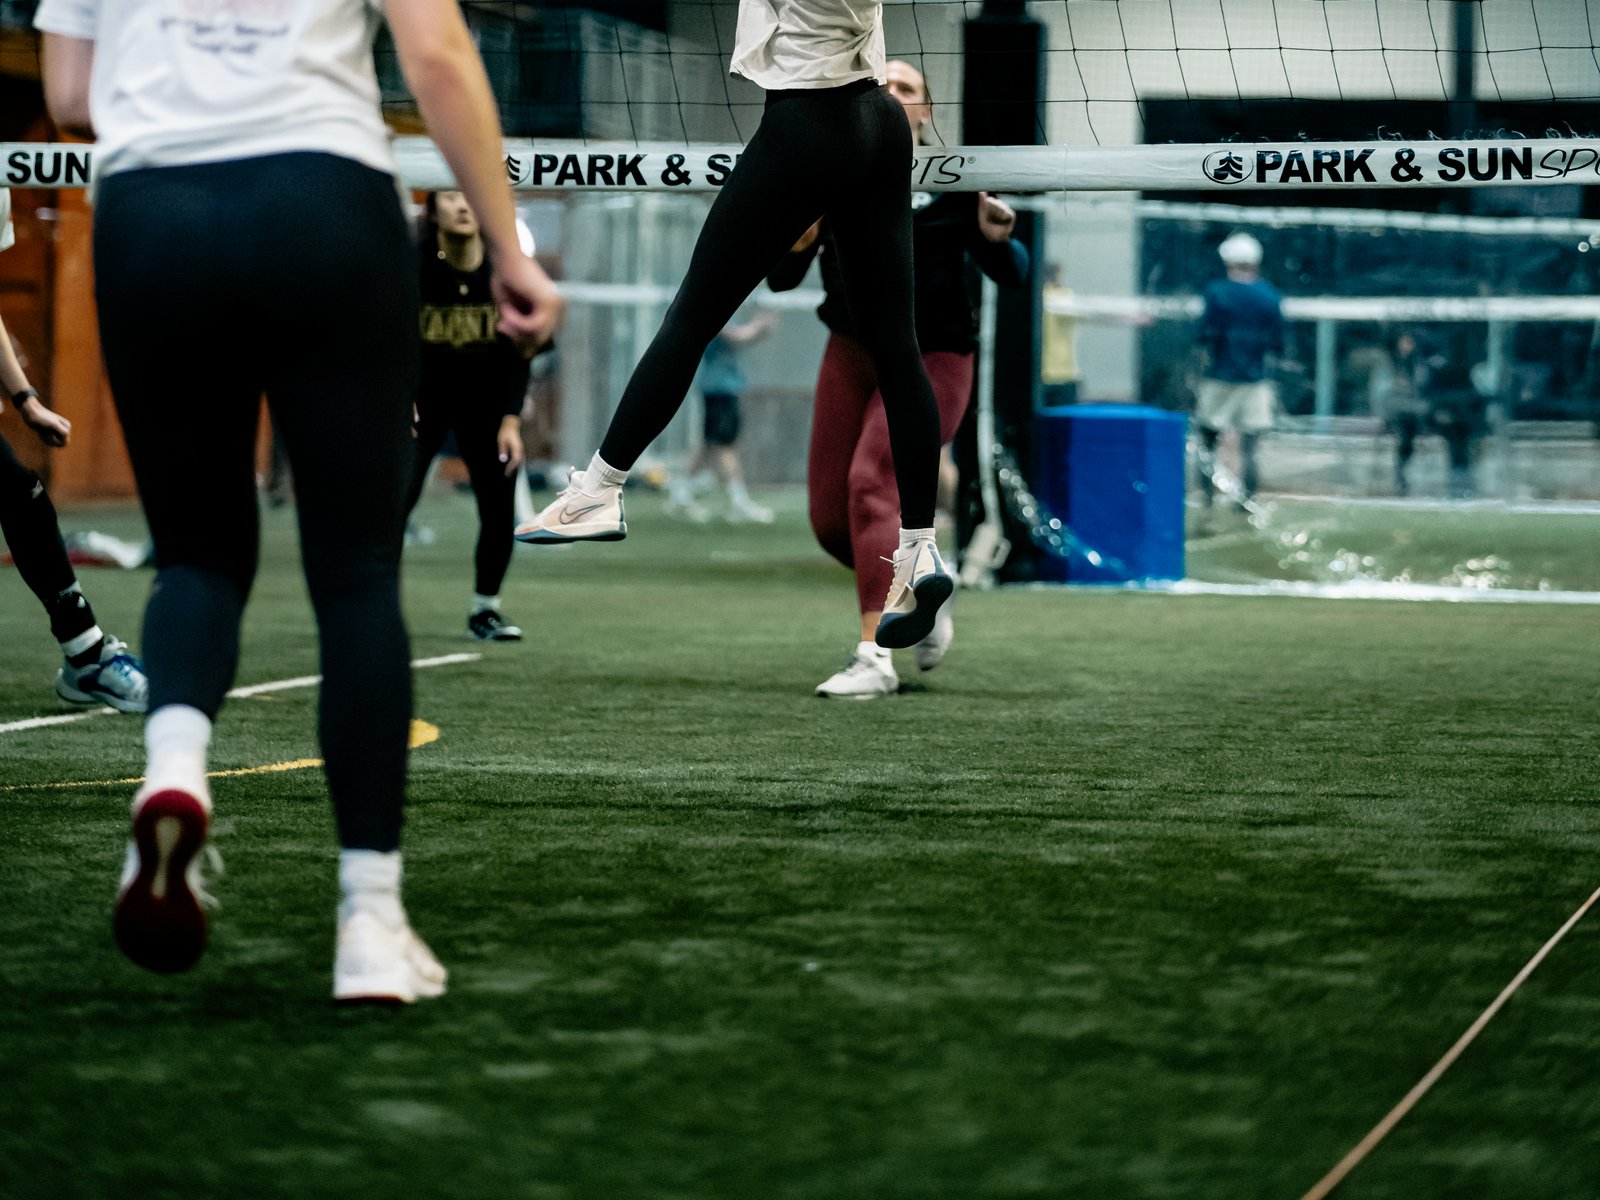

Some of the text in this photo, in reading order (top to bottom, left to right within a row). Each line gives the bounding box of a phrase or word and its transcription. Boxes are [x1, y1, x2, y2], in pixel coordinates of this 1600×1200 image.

[7, 151, 91, 184] SUN
[532, 153, 648, 187] PARK
[660, 153, 692, 186] &
[1256, 148, 1376, 184] PARK
[1390, 147, 1424, 183] &
